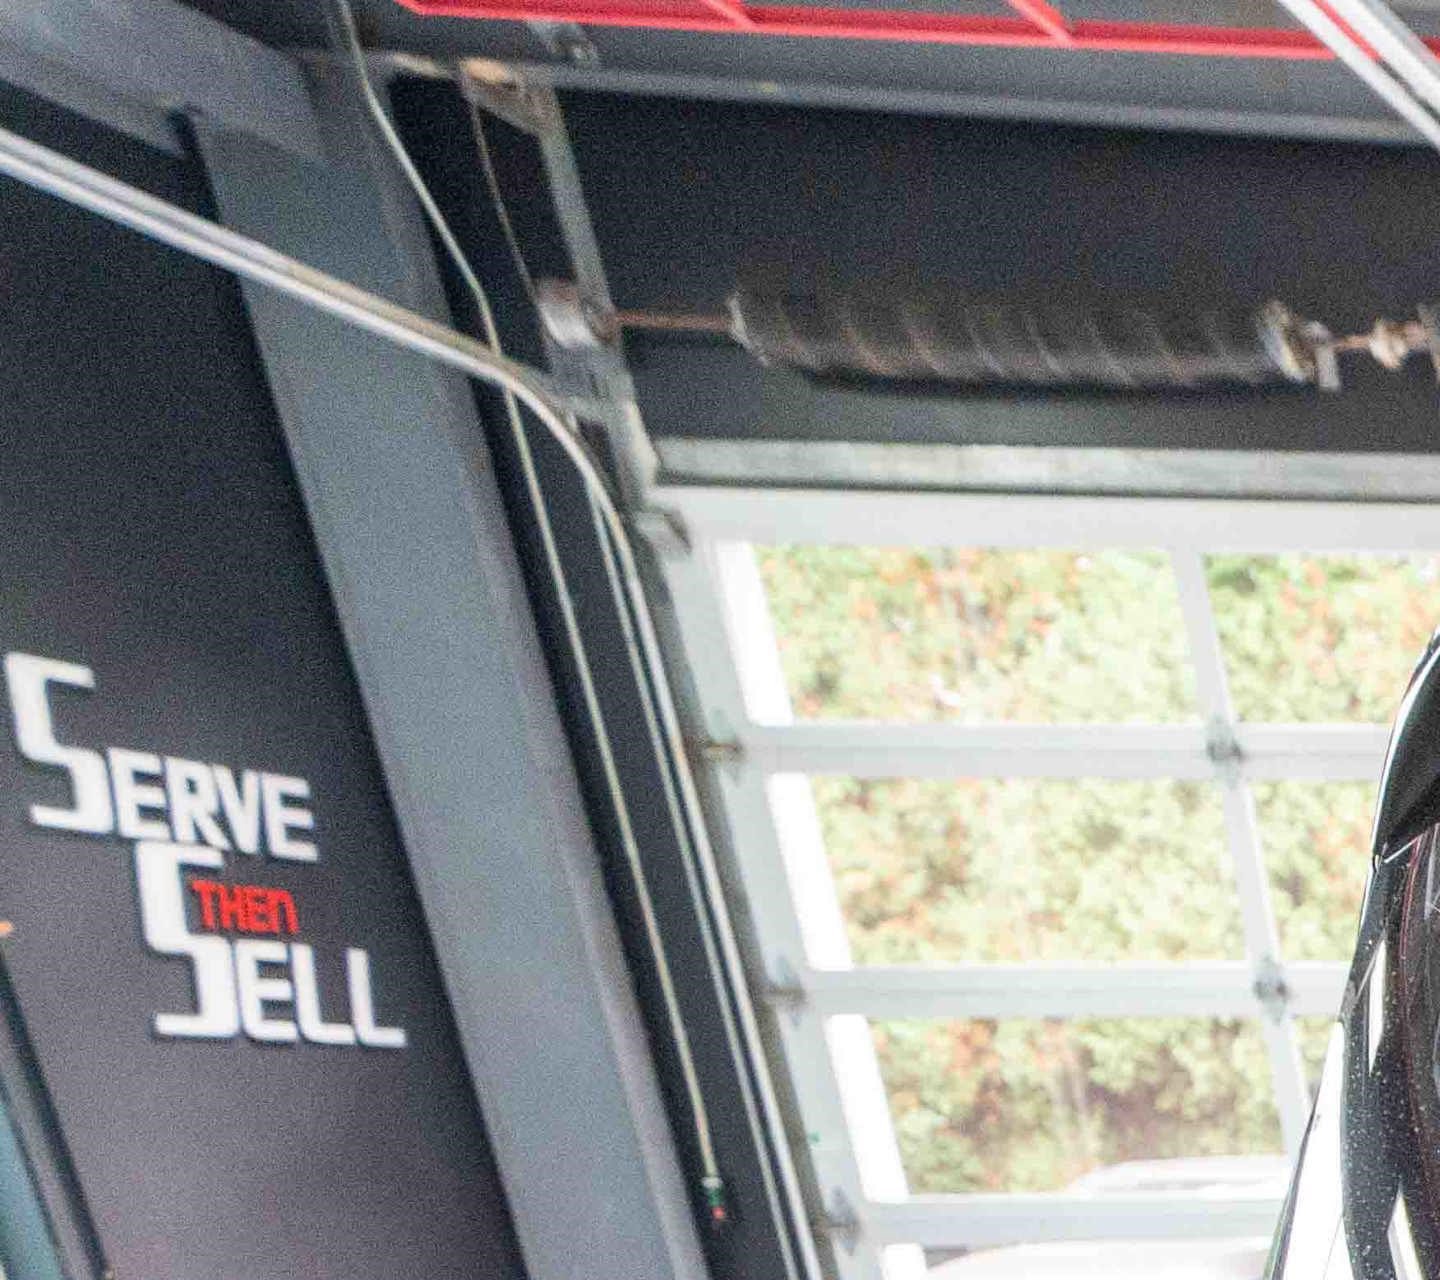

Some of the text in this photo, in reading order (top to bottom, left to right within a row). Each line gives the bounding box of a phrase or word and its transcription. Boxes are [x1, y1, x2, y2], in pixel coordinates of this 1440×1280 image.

[3, 651, 319, 863] SERVE
[135, 840, 407, 1048] SELL
[190, 878, 300, 935] THEN
